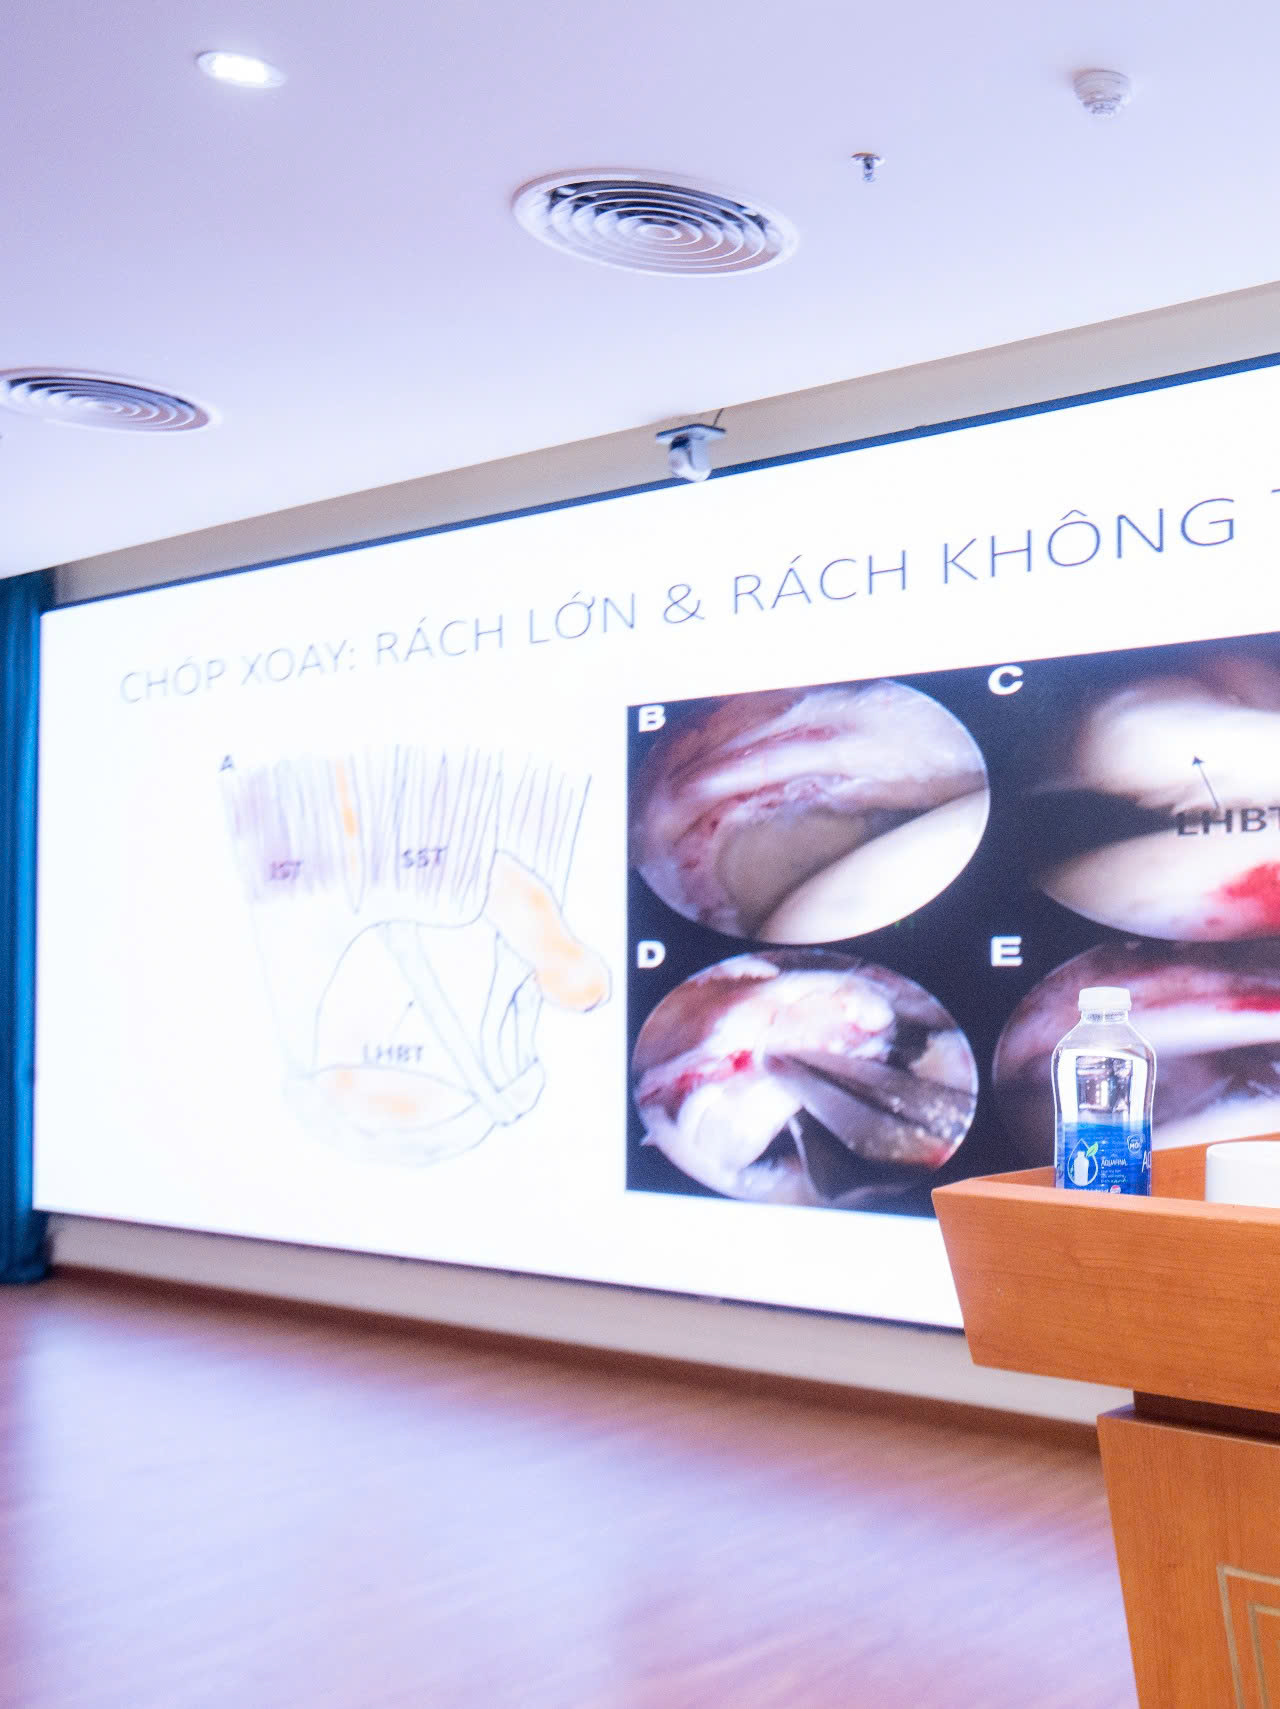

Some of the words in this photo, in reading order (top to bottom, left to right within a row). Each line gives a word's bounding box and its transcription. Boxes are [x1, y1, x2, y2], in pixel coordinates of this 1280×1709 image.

[120, 656, 226, 704] CHÓP
[240, 639, 357, 686] XOAY:
[375, 614, 504, 664] RÁCH
[528, 591, 636, 645] LỚN
[662, 583, 706, 625] &
[732, 549, 908, 615] RÁCH
[942, 496, 1236, 584] KHÔNG
[988, 665, 1024, 696] C
[638, 705, 666, 733] B
[219, 754, 235, 773] A
[401, 847, 448, 869] SST
[637, 940, 666, 969] D
[991, 937, 1023, 967] E
